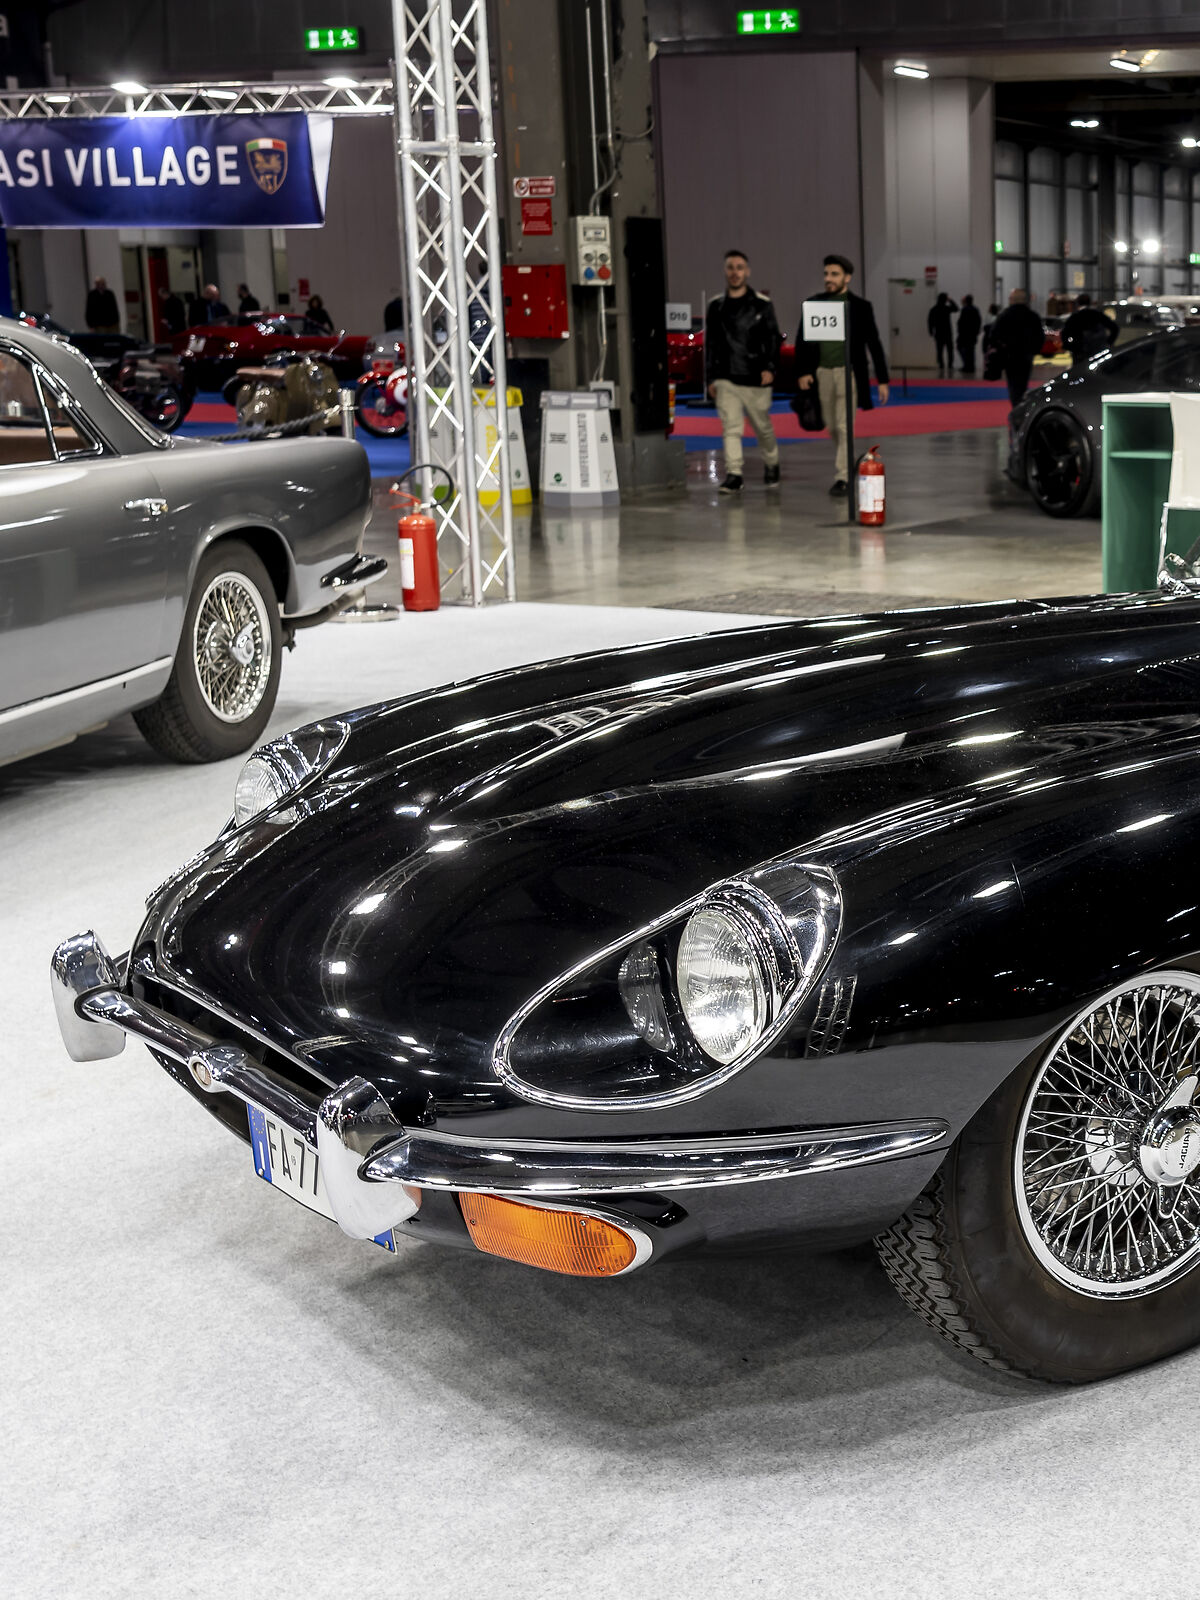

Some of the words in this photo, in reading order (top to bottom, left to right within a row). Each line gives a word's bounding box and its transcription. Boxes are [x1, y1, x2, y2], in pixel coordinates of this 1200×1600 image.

[64, 146, 241, 187] VILLAGE
[810, 315, 838, 328] D13
[1178, 1126, 1191, 1169] JAGUAR
